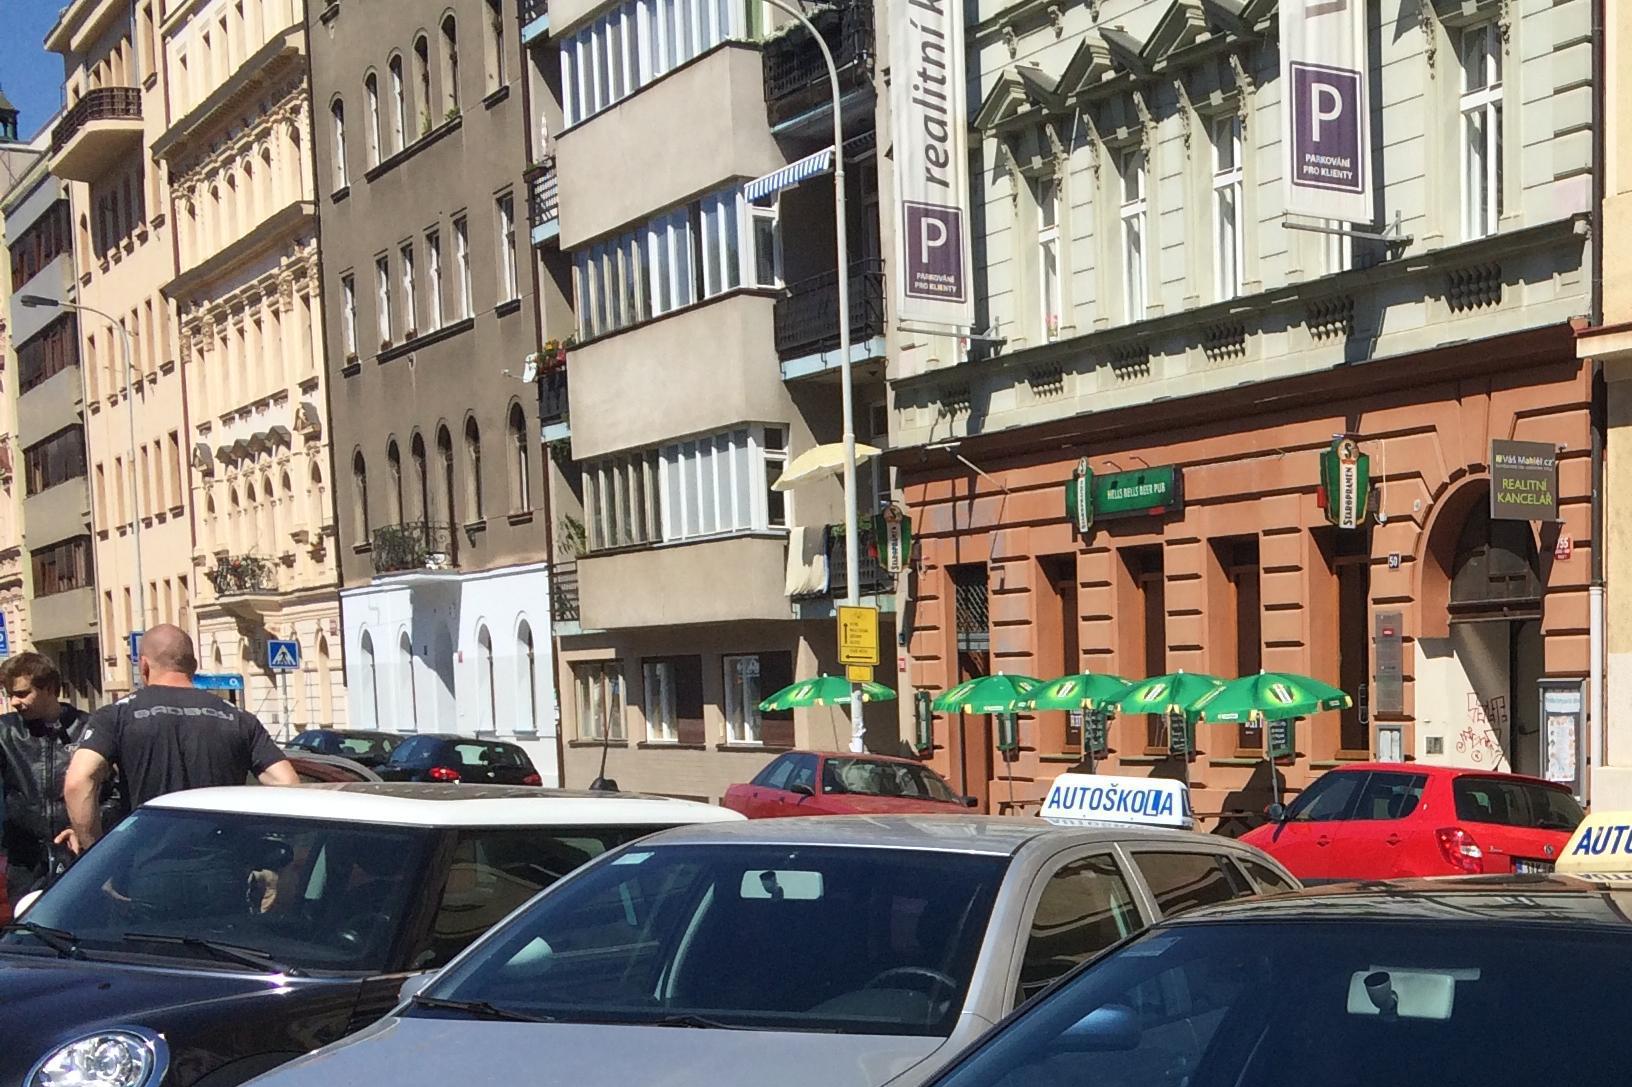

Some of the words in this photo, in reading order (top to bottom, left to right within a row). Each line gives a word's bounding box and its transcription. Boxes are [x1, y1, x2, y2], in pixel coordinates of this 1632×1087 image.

[909, 17, 950, 189] realitní
[1310, 82, 1343, 143] P
[1304, 153, 1351, 168] PARKOVÁNÍ
[1302, 165, 1320, 176] PRO
[1320, 167, 1353, 180] KLIENTY
[920, 216, 948, 264] P
[1153, 482, 1166, 494] PUB
[1502, 478, 1548, 492] REALITNÍ
[1497, 491, 1553, 505] KANCELÁŘ
[1389, 555, 1399, 567] 50
[1047, 782, 1174, 817] AUTOŠKOLA
